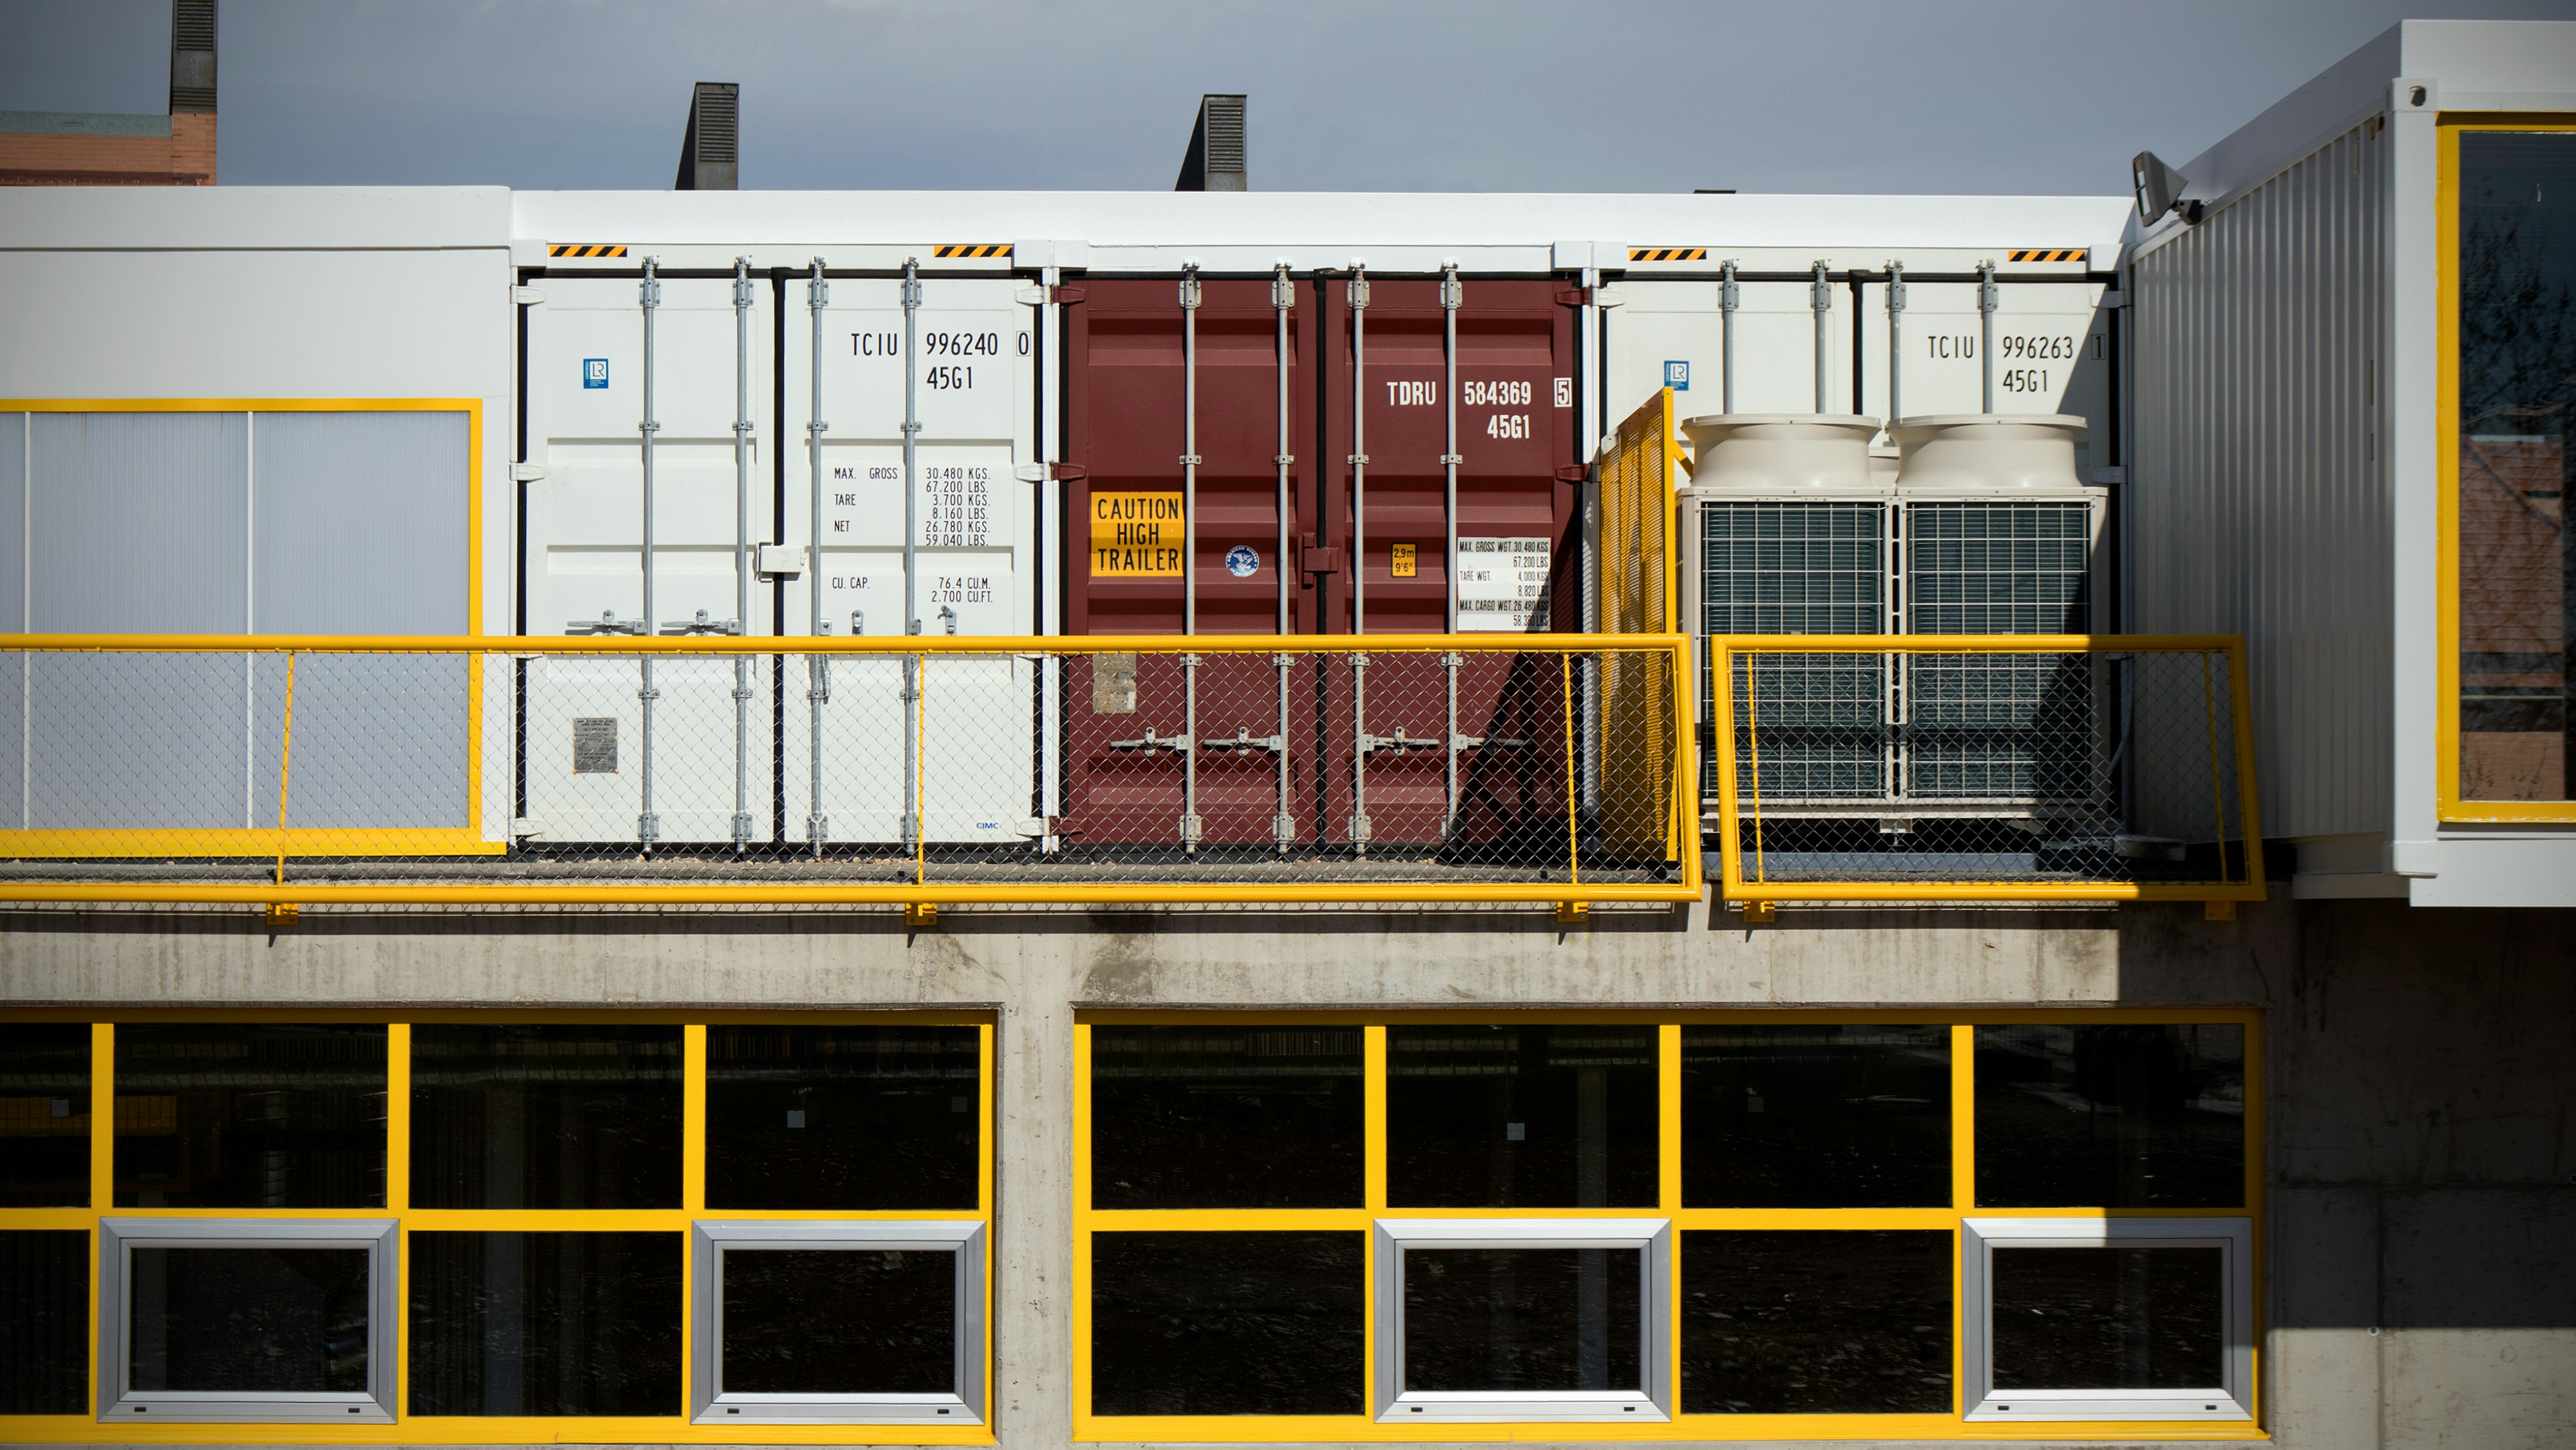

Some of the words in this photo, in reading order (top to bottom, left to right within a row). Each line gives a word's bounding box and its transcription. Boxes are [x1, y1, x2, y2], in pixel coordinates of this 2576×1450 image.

[851, 333, 897, 356] TCIU
[927, 332, 998, 355] 996240
[1928, 336, 1973, 358] TCIU
[2003, 336, 2073, 359] 996263
[927, 367, 972, 389] 45G1
[2003, 370, 2047, 392] 45G1
[1387, 381, 1436, 406] TDRU
[1464, 381, 1531, 405] 584369
[1556, 379, 1570, 406] 5
[1487, 415, 1530, 439] 45G1
[834, 468, 857, 479] MAX.
[869, 468, 898, 479] GROSS
[969, 468, 990, 479] KGS.
[968, 481, 989, 493] LBS.
[835, 494, 856, 506] TARE
[968, 494, 990, 506] KGS.
[968, 507, 989, 519] LBS.
[1098, 499, 1178, 519] CAUTION
[834, 520, 850, 532] NET
[968, 520, 990, 533] KGS.
[968, 534, 989, 546] LBS.
[1117, 523, 1159, 545] HIGH
[1459, 541, 1473, 552] MAX.
[1475, 541, 1495, 552] GROSS
[1497, 541, 1513, 552] WGT.
[1537, 541, 1549, 552] KGS
[1098, 549, 1178, 571] TRAILER
[1537, 557, 1548, 568] LBS
[1459, 571, 1473, 581] TARE
[1477, 571, 1492, 581] WGT.
[1537, 571, 1549, 582] KGS
[832, 577, 846, 589] CU.
[850, 577, 870, 589] CAP.
[938, 577, 962, 589] 76.4
[967, 577, 990, 589] CU.M.
[967, 591, 993, 603] CU.FT.
[1537, 586, 1549, 596] LBS
[1459, 600, 1473, 611] MAX.
[1475, 600, 1495, 611] CARGO
[1497, 600, 1513, 611] WGT.
[1537, 600, 1549, 611] KGS
[1537, 615, 1548, 627] LBS
